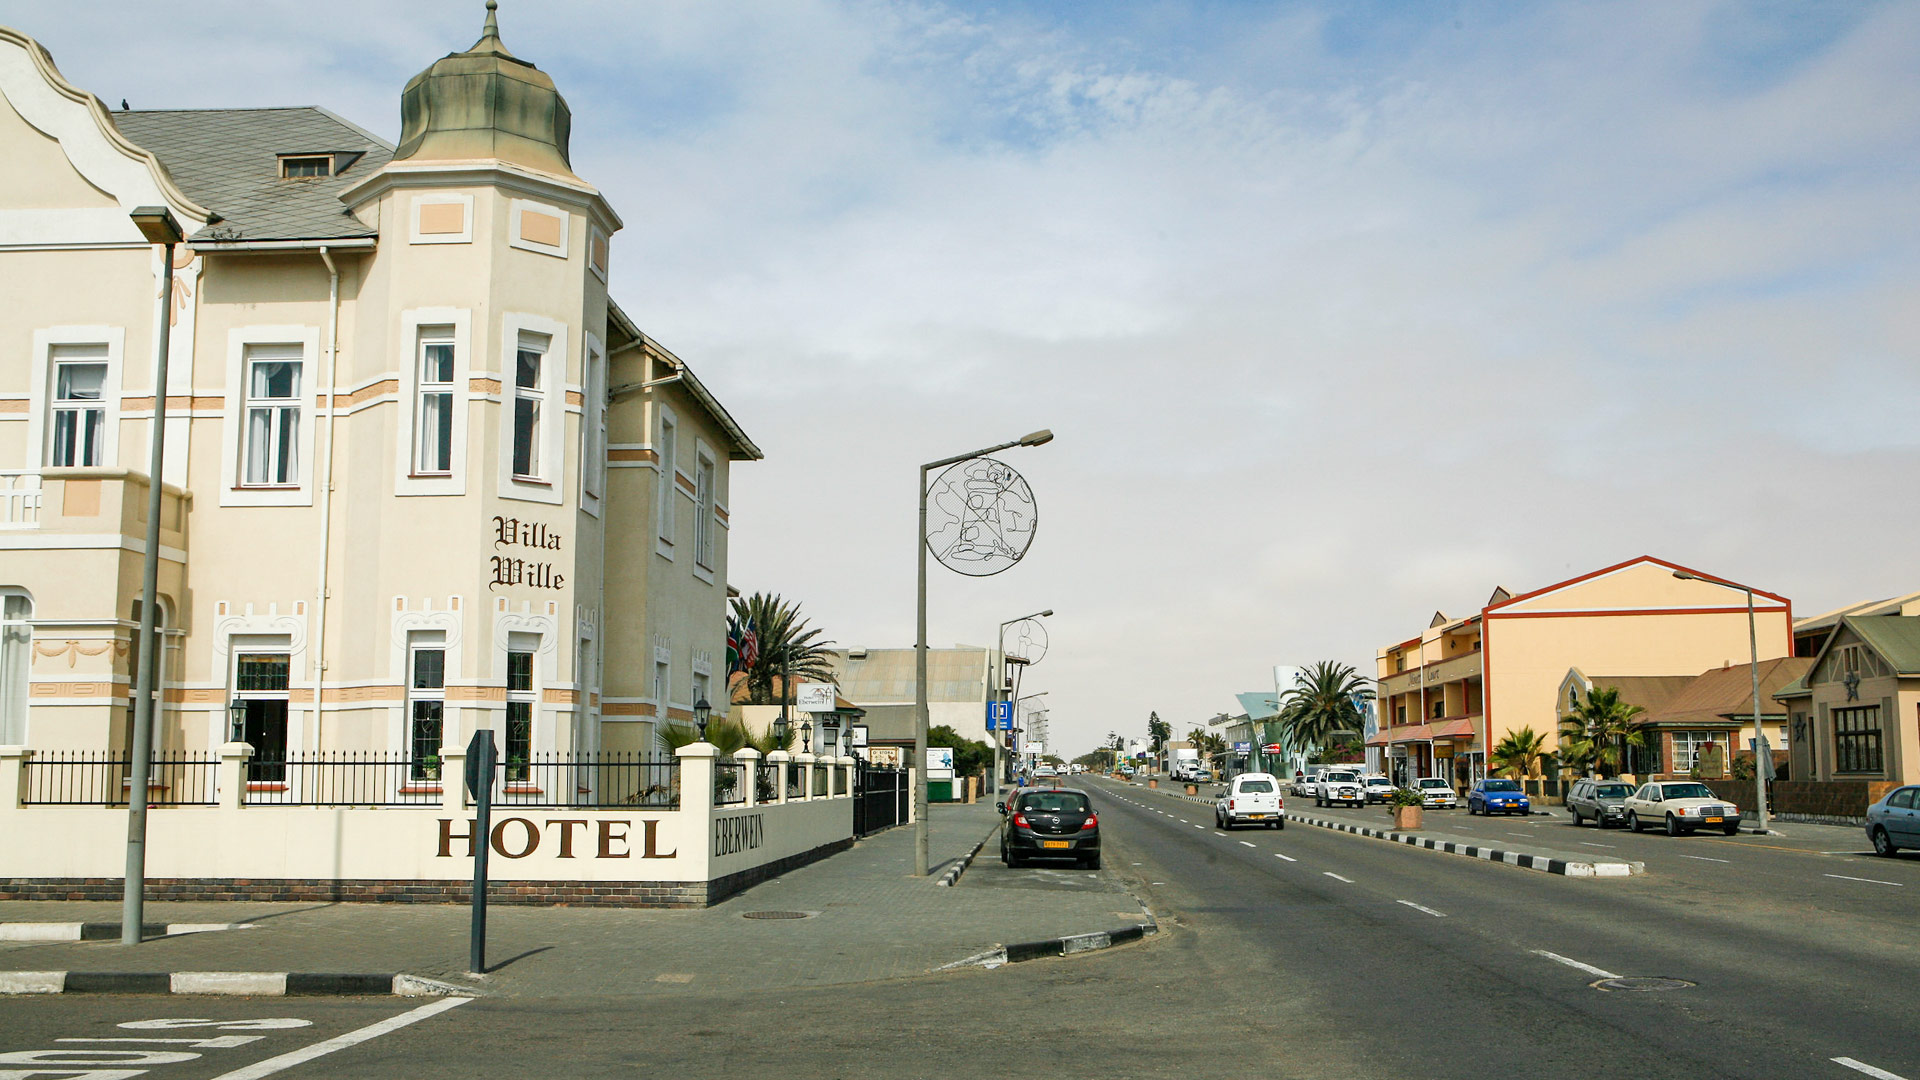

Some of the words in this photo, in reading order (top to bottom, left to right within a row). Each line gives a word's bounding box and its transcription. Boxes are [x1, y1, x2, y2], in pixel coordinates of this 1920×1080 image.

[492, 515, 562, 551] Villa
[489, 555, 565, 592] Wille
[436, 817, 677, 859] HOTEL
[715, 813, 764, 857] EBERWEIN
